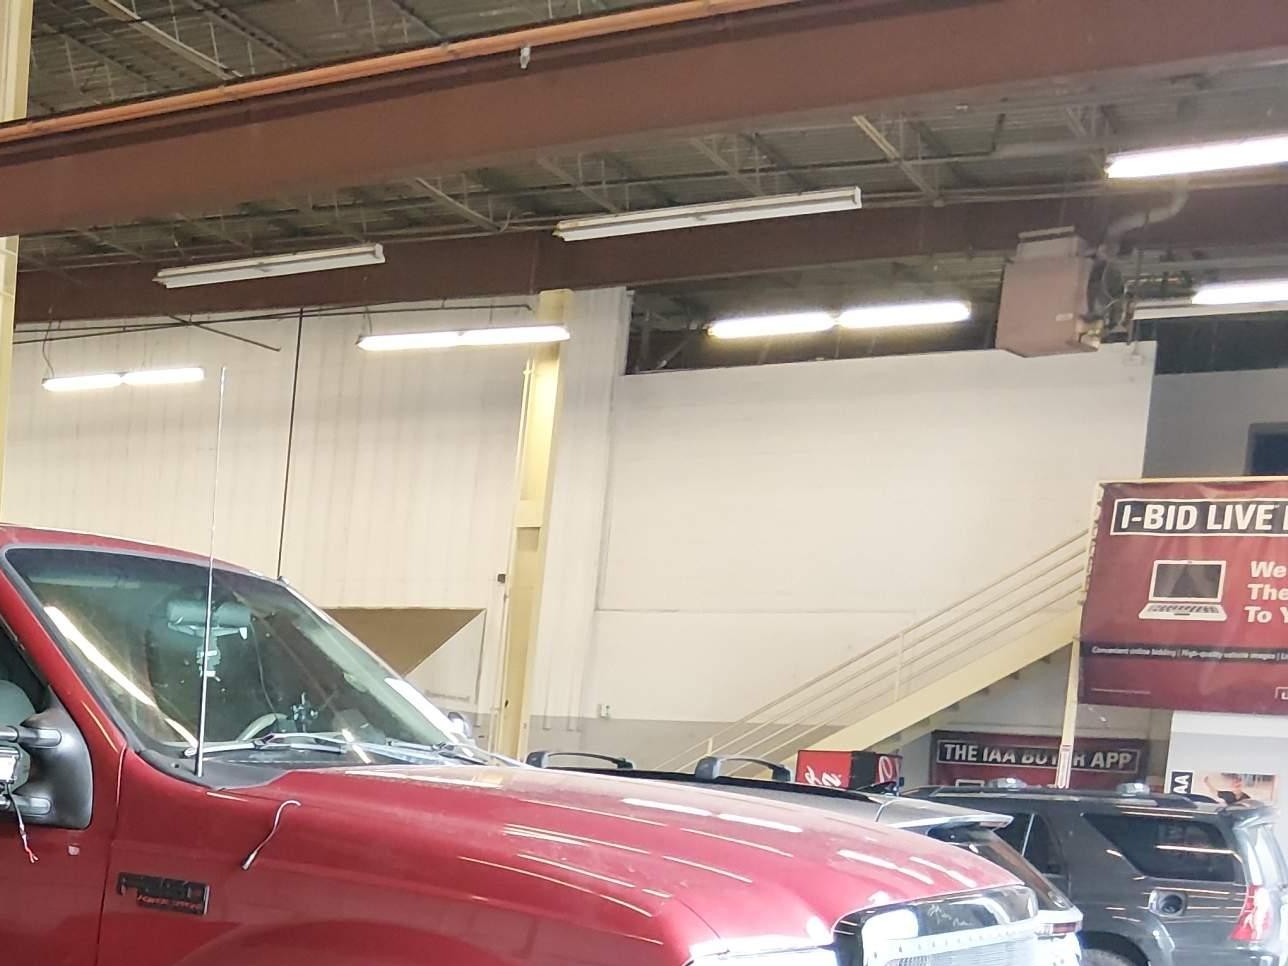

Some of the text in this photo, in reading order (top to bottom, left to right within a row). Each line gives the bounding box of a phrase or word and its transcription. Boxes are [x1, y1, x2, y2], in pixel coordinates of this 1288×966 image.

[1121, 504, 1198, 531] I-BID
[1250, 560, 1287, 578] We
[1247, 583, 1288, 601] The
[1244, 605, 1273, 623] To
[944, 743, 1132, 769] THE IAA BUR APP
[1173, 774, 1191, 794] AA
